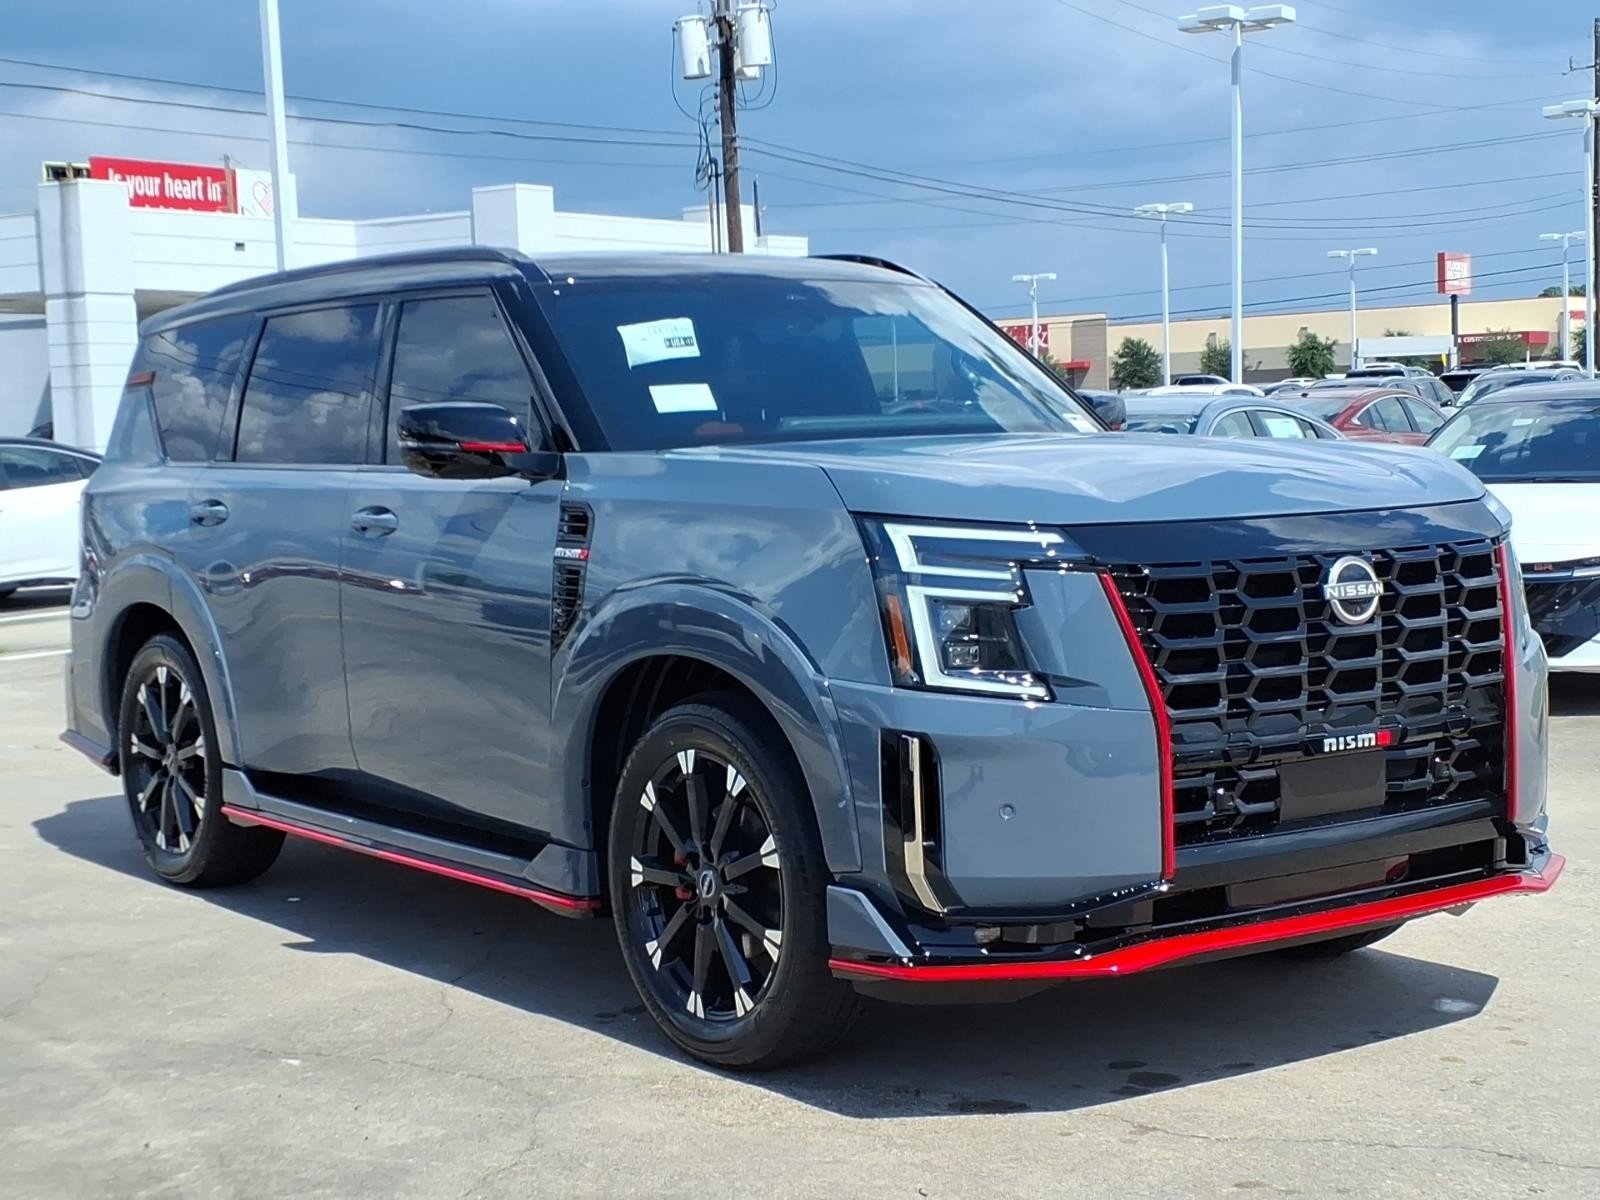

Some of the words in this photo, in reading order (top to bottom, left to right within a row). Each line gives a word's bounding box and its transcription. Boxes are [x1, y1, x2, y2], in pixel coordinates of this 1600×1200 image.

[126, 174, 161, 200] your
[164, 171, 205, 202] heart
[206, 176, 222, 202] in
[1326, 581, 1384, 598] NISSAN
